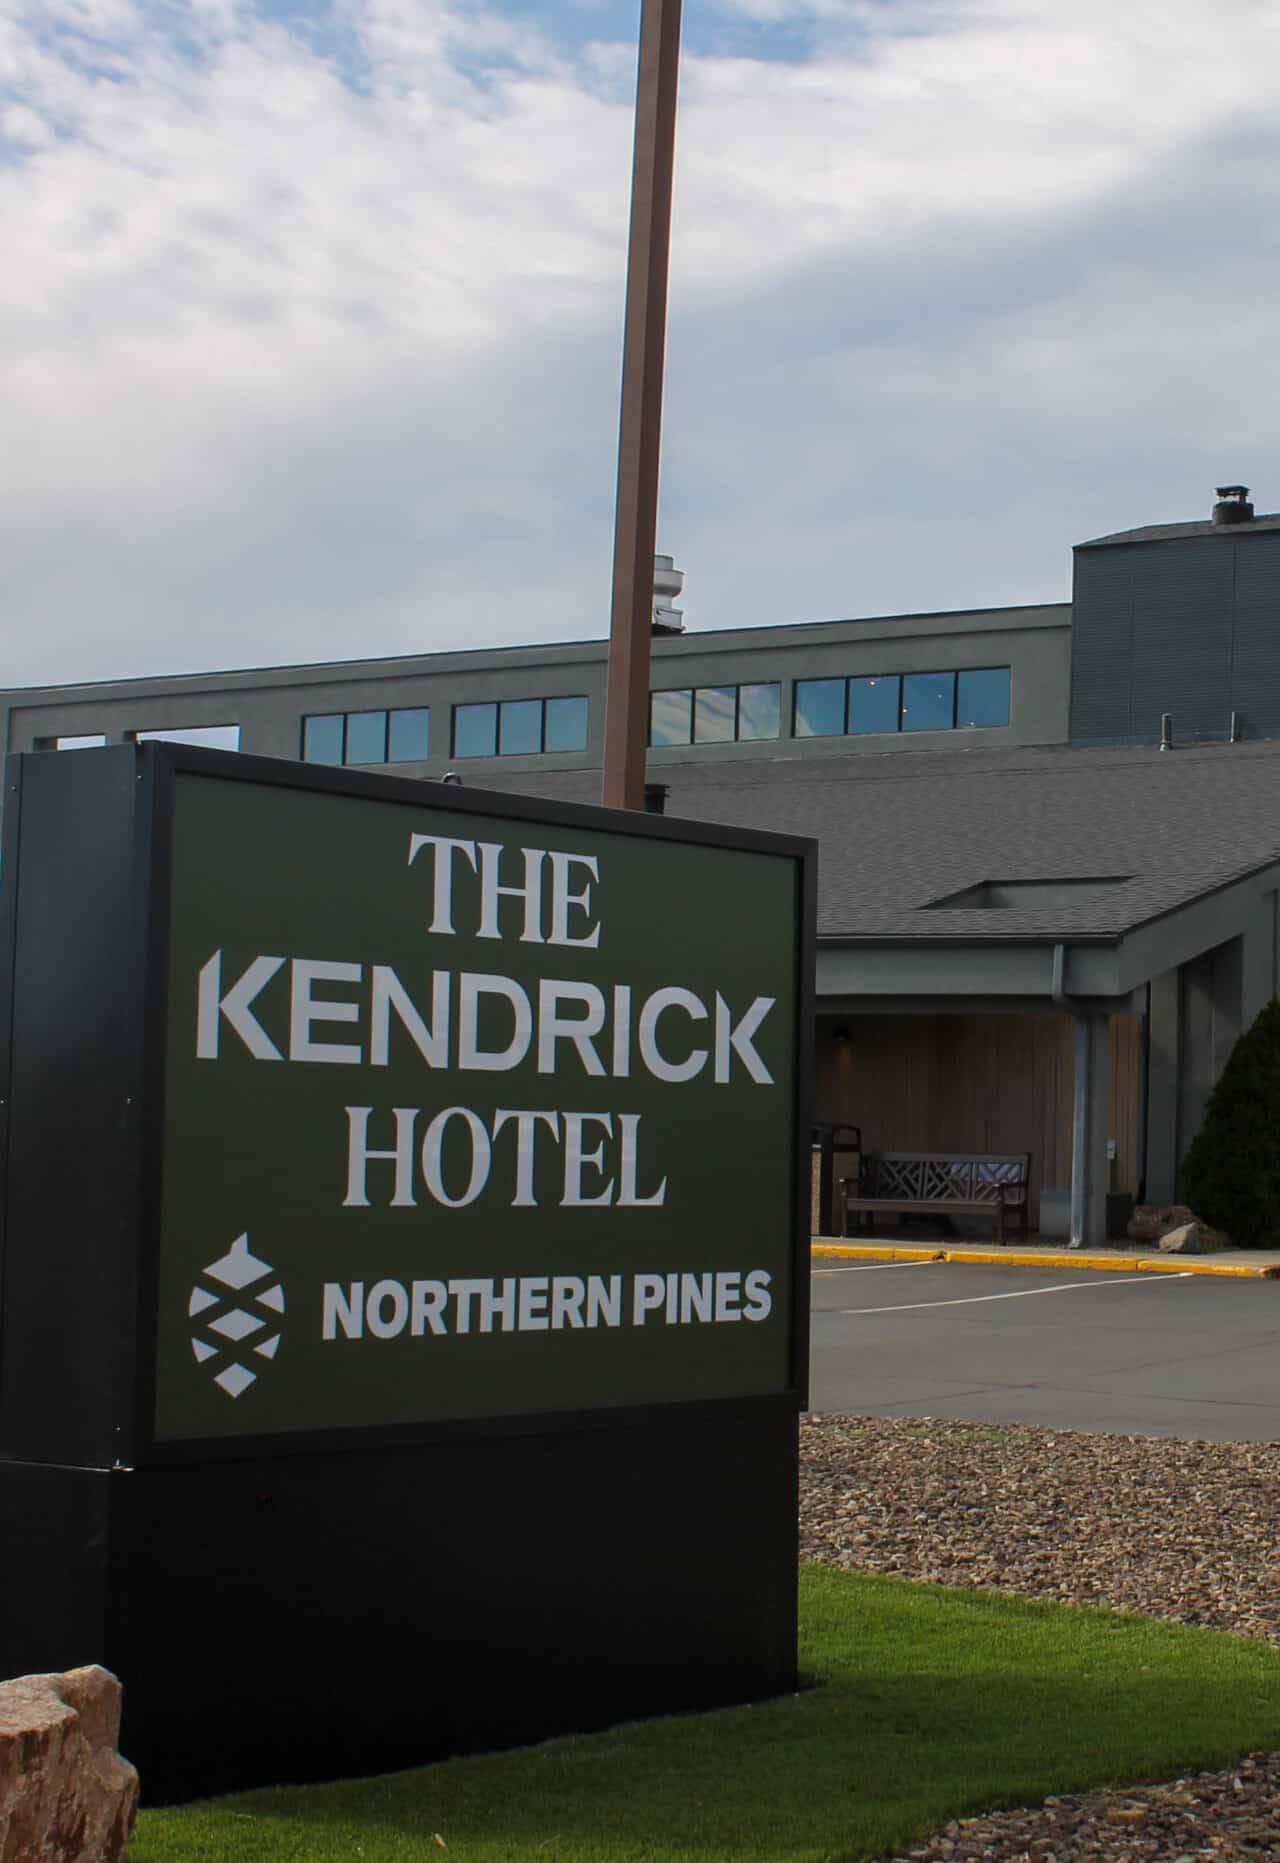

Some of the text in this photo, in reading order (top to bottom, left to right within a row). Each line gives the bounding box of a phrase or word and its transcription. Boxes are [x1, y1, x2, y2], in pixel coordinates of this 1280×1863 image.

[407, 833, 601, 949] THE
[196, 950, 775, 1084] KENDRICK
[342, 1106, 667, 1207] HOTEL
[322, 1270, 772, 1340] NORTHERN PINES
